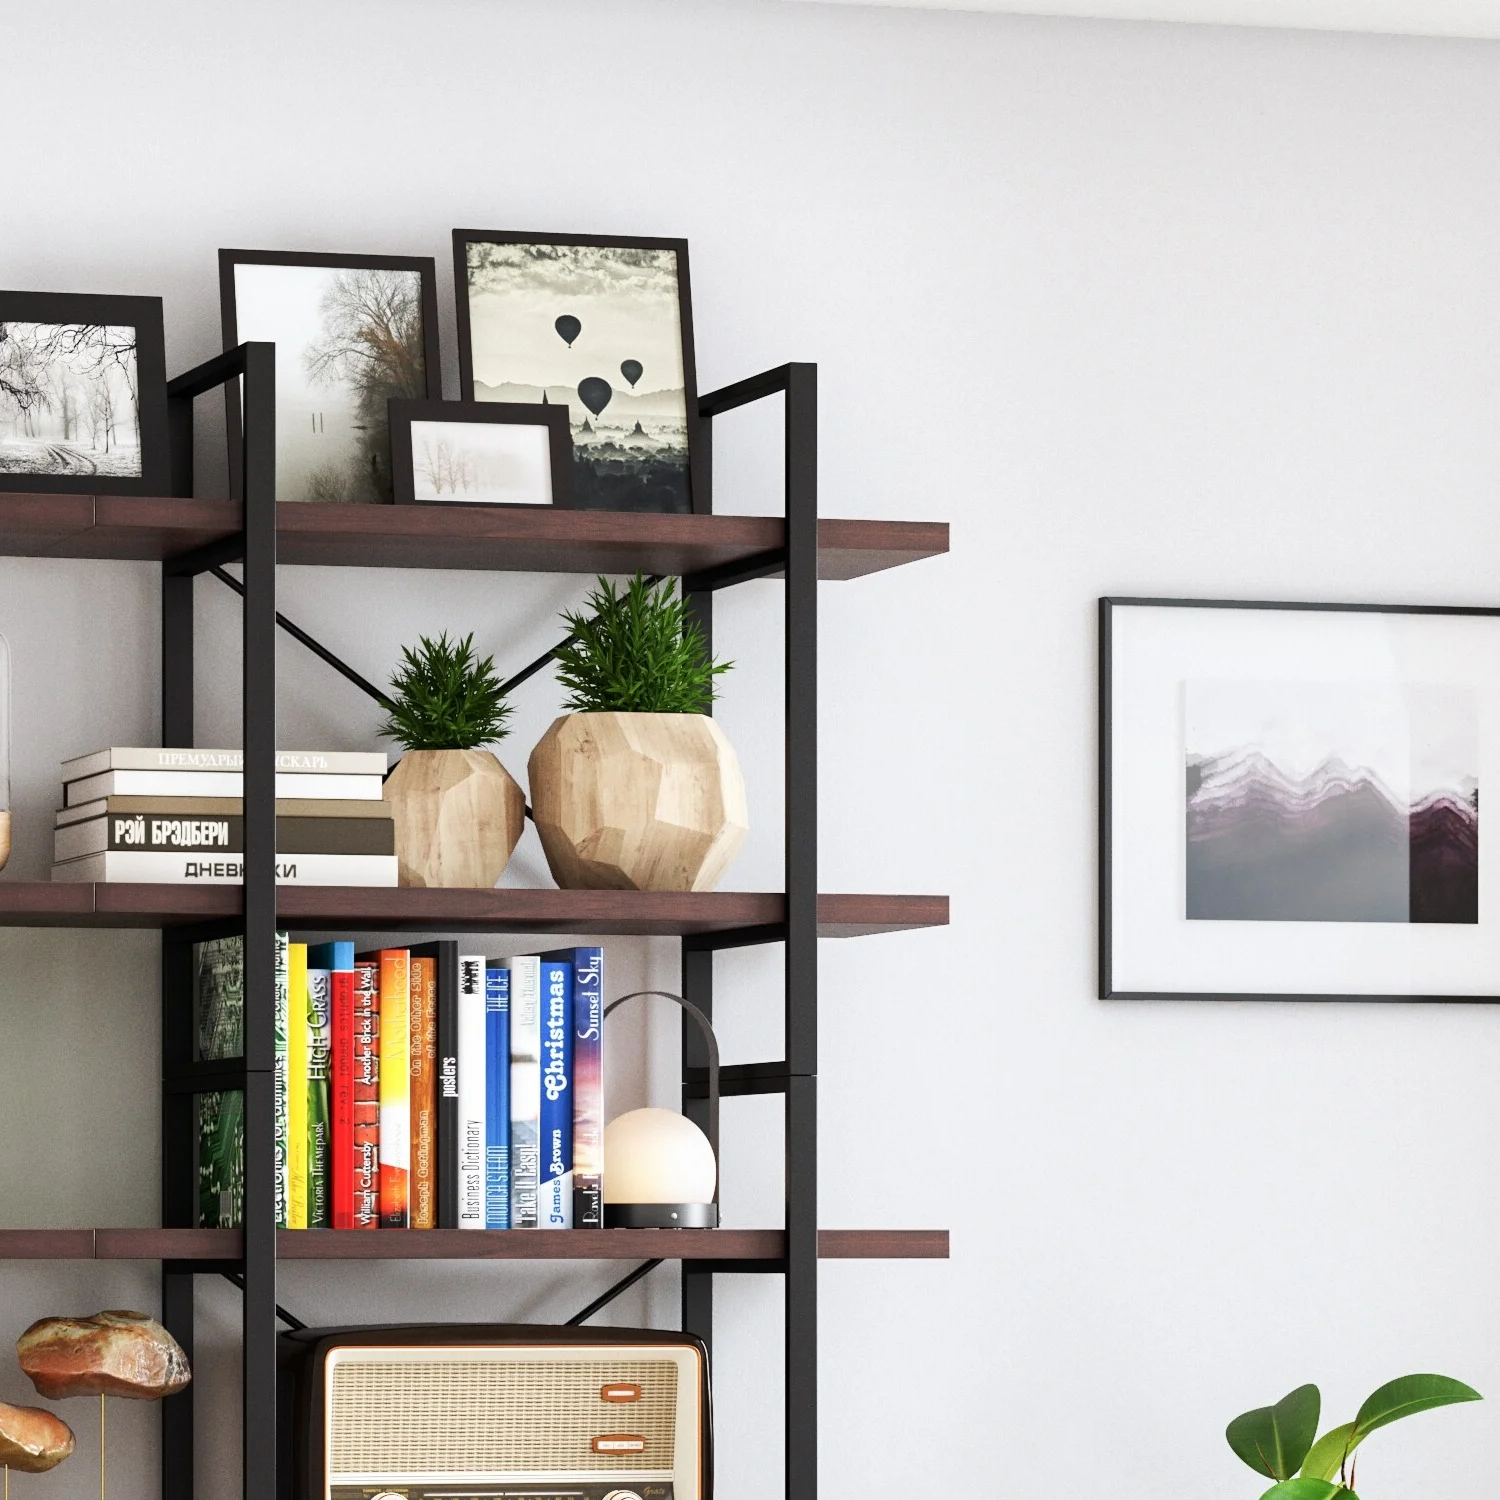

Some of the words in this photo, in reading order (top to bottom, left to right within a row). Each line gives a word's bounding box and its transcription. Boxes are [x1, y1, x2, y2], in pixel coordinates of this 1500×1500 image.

[114, 815, 146, 845] РЭЙ
[151, 820, 229, 847] БРЭДБЕРИ
[577, 956, 601, 987] Sky
[486, 993, 508, 1013] THE
[577, 991, 600, 1041] Sunset
[360, 1019, 372, 1044] Brick
[544, 970, 568, 1101] Christmas
[360, 1046, 372, 1085] Another
[442, 1057, 458, 1098] posters
[461, 1120, 483, 1171] Dictionary
[486, 1145, 508, 1181] STEAM
[514, 1143, 540, 1177] Easy!
[549, 1129, 565, 1176] Brown
[360, 1189, 371, 1225] William
[461, 1174, 480, 1220] Business
[514, 1192, 538, 1224] Take
[549, 1179, 564, 1224] James
